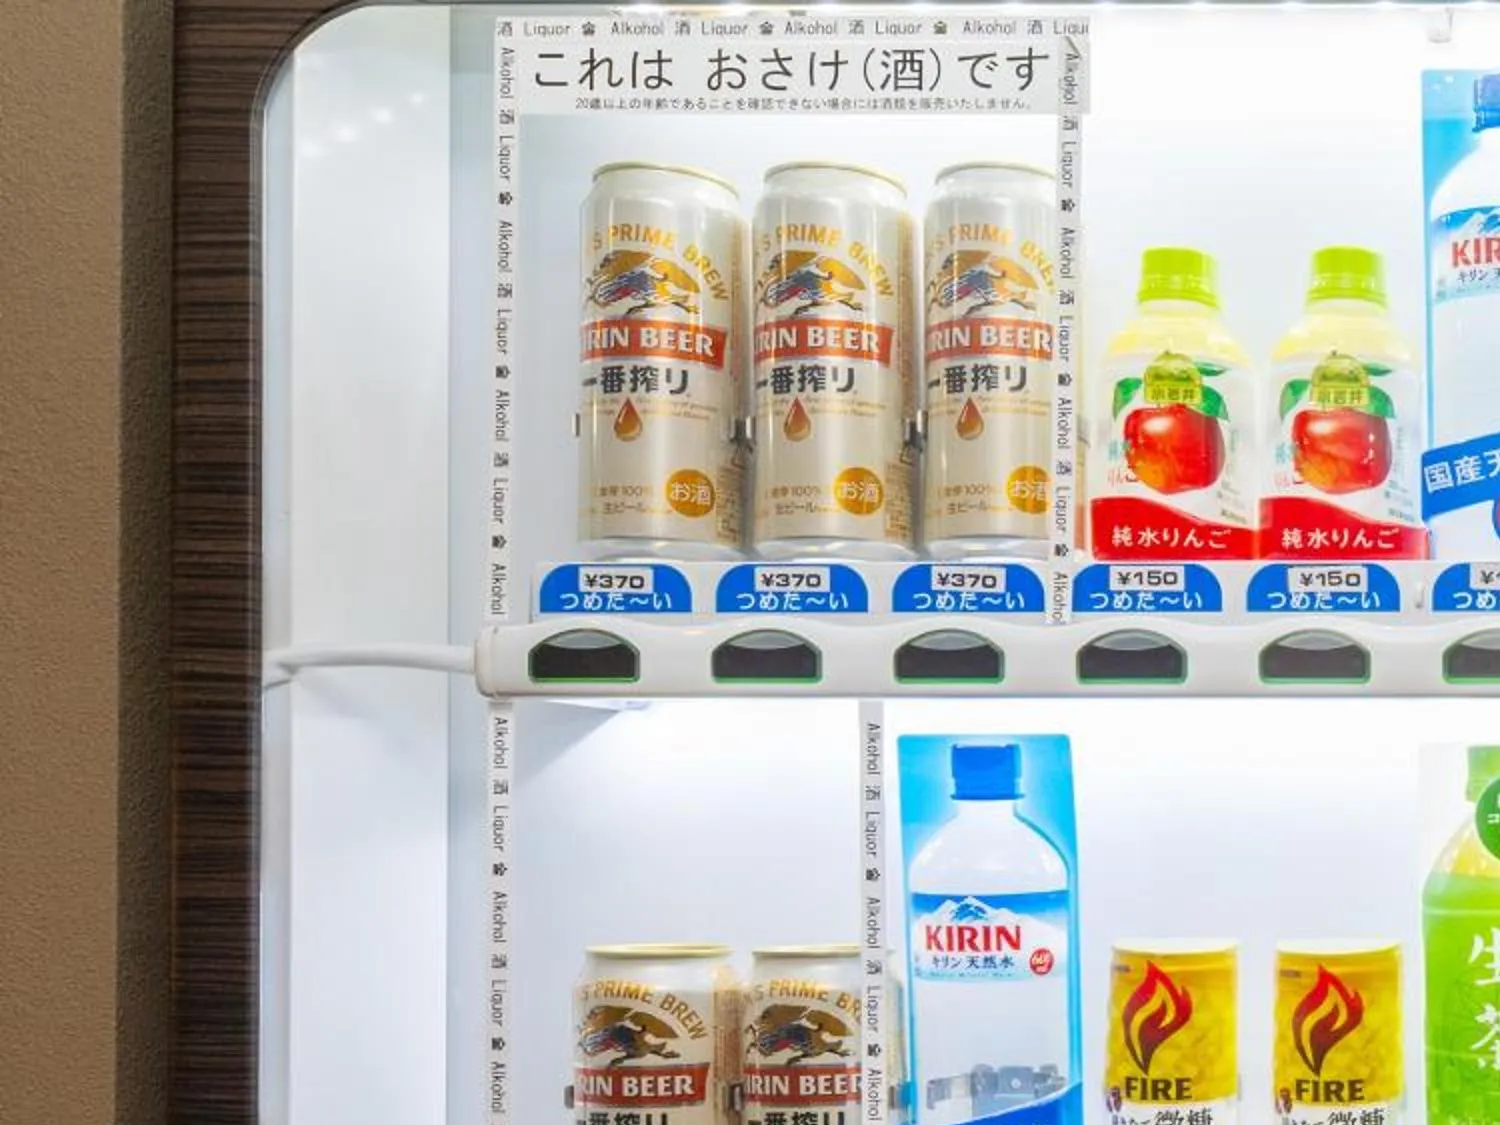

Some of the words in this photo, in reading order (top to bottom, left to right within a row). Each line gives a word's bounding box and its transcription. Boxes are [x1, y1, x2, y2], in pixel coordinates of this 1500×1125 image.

[523, 21, 571, 37] Liquor
[610, 21, 665, 35] Alkohol
[701, 21, 749, 37] Liquor
[784, 21, 838, 35] Alkohol
[875, 21, 922, 36] Liquor
[963, 20, 1017, 34] Alkohol
[535, 47, 673, 91] これは
[607, 223, 675, 249] PRIME
[640, 326, 715, 358] BEER
[807, 325, 880, 354] BEER
[582, 365, 690, 395] 一番搾り
[927, 364, 1028, 394] 一番搾り
[1056, 397, 1072, 449] Alkohol
[1112, 526, 1232, 550] 純水りんご
[1281, 527, 1399, 550] 純水りんご
[584, 574, 645, 590] ¥370
[760, 573, 821, 588] ¥370
[936, 573, 997, 589] ¥370
[1117, 571, 1179, 586] ¥150
[1299, 572, 1361, 588] ¥150
[925, 925, 1022, 952] KIRIN
[594, 980, 653, 1004] PRIME
[660, 995, 708, 1041] BREW
[622, 1076, 695, 1098] BEER
[867, 1068, 882, 1121] Alkohol
[1124, 1076, 1193, 1101] FIRE
[1295, 1079, 1365, 1103] FIRE
